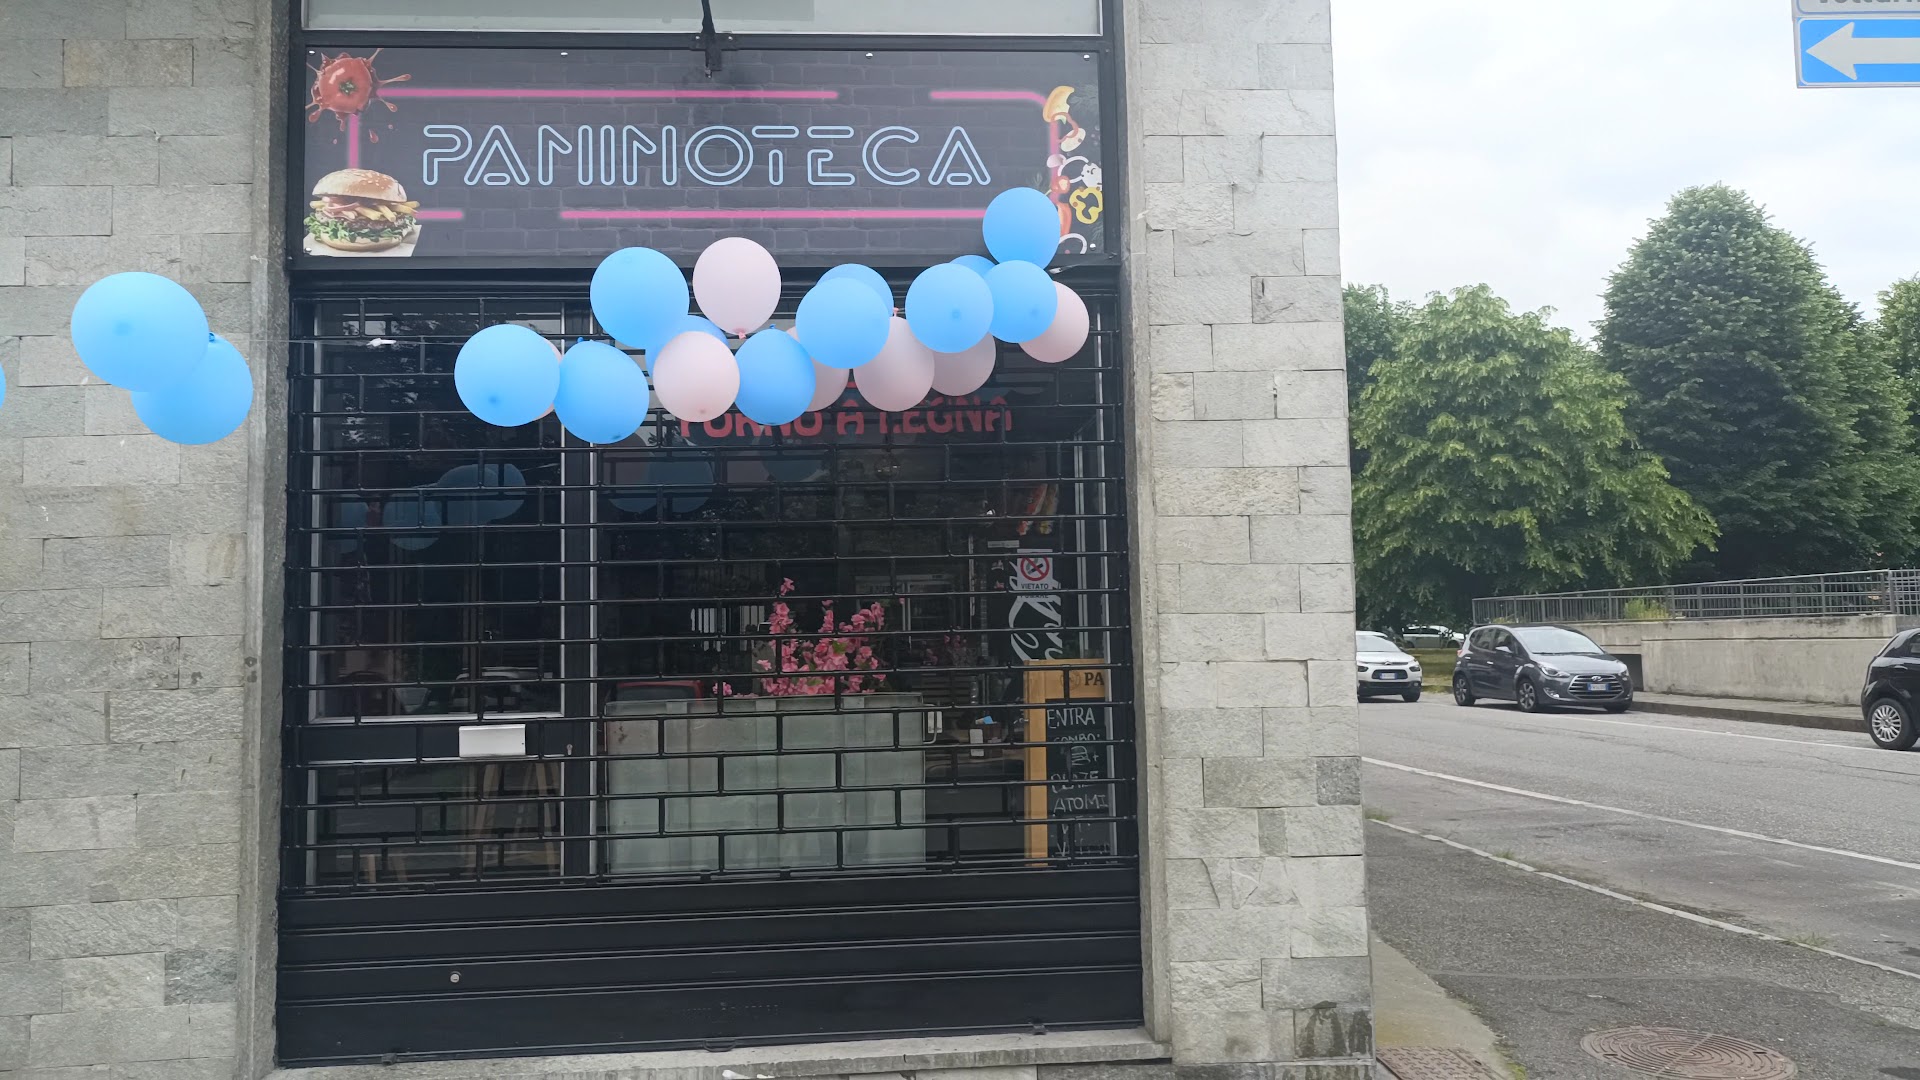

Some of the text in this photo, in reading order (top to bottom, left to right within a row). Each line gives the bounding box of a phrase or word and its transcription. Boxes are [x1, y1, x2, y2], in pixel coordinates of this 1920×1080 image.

[423, 124, 991, 185] PANINOTECA
[835, 399, 865, 435] A
[1046, 707, 1096, 729] ENTRA
